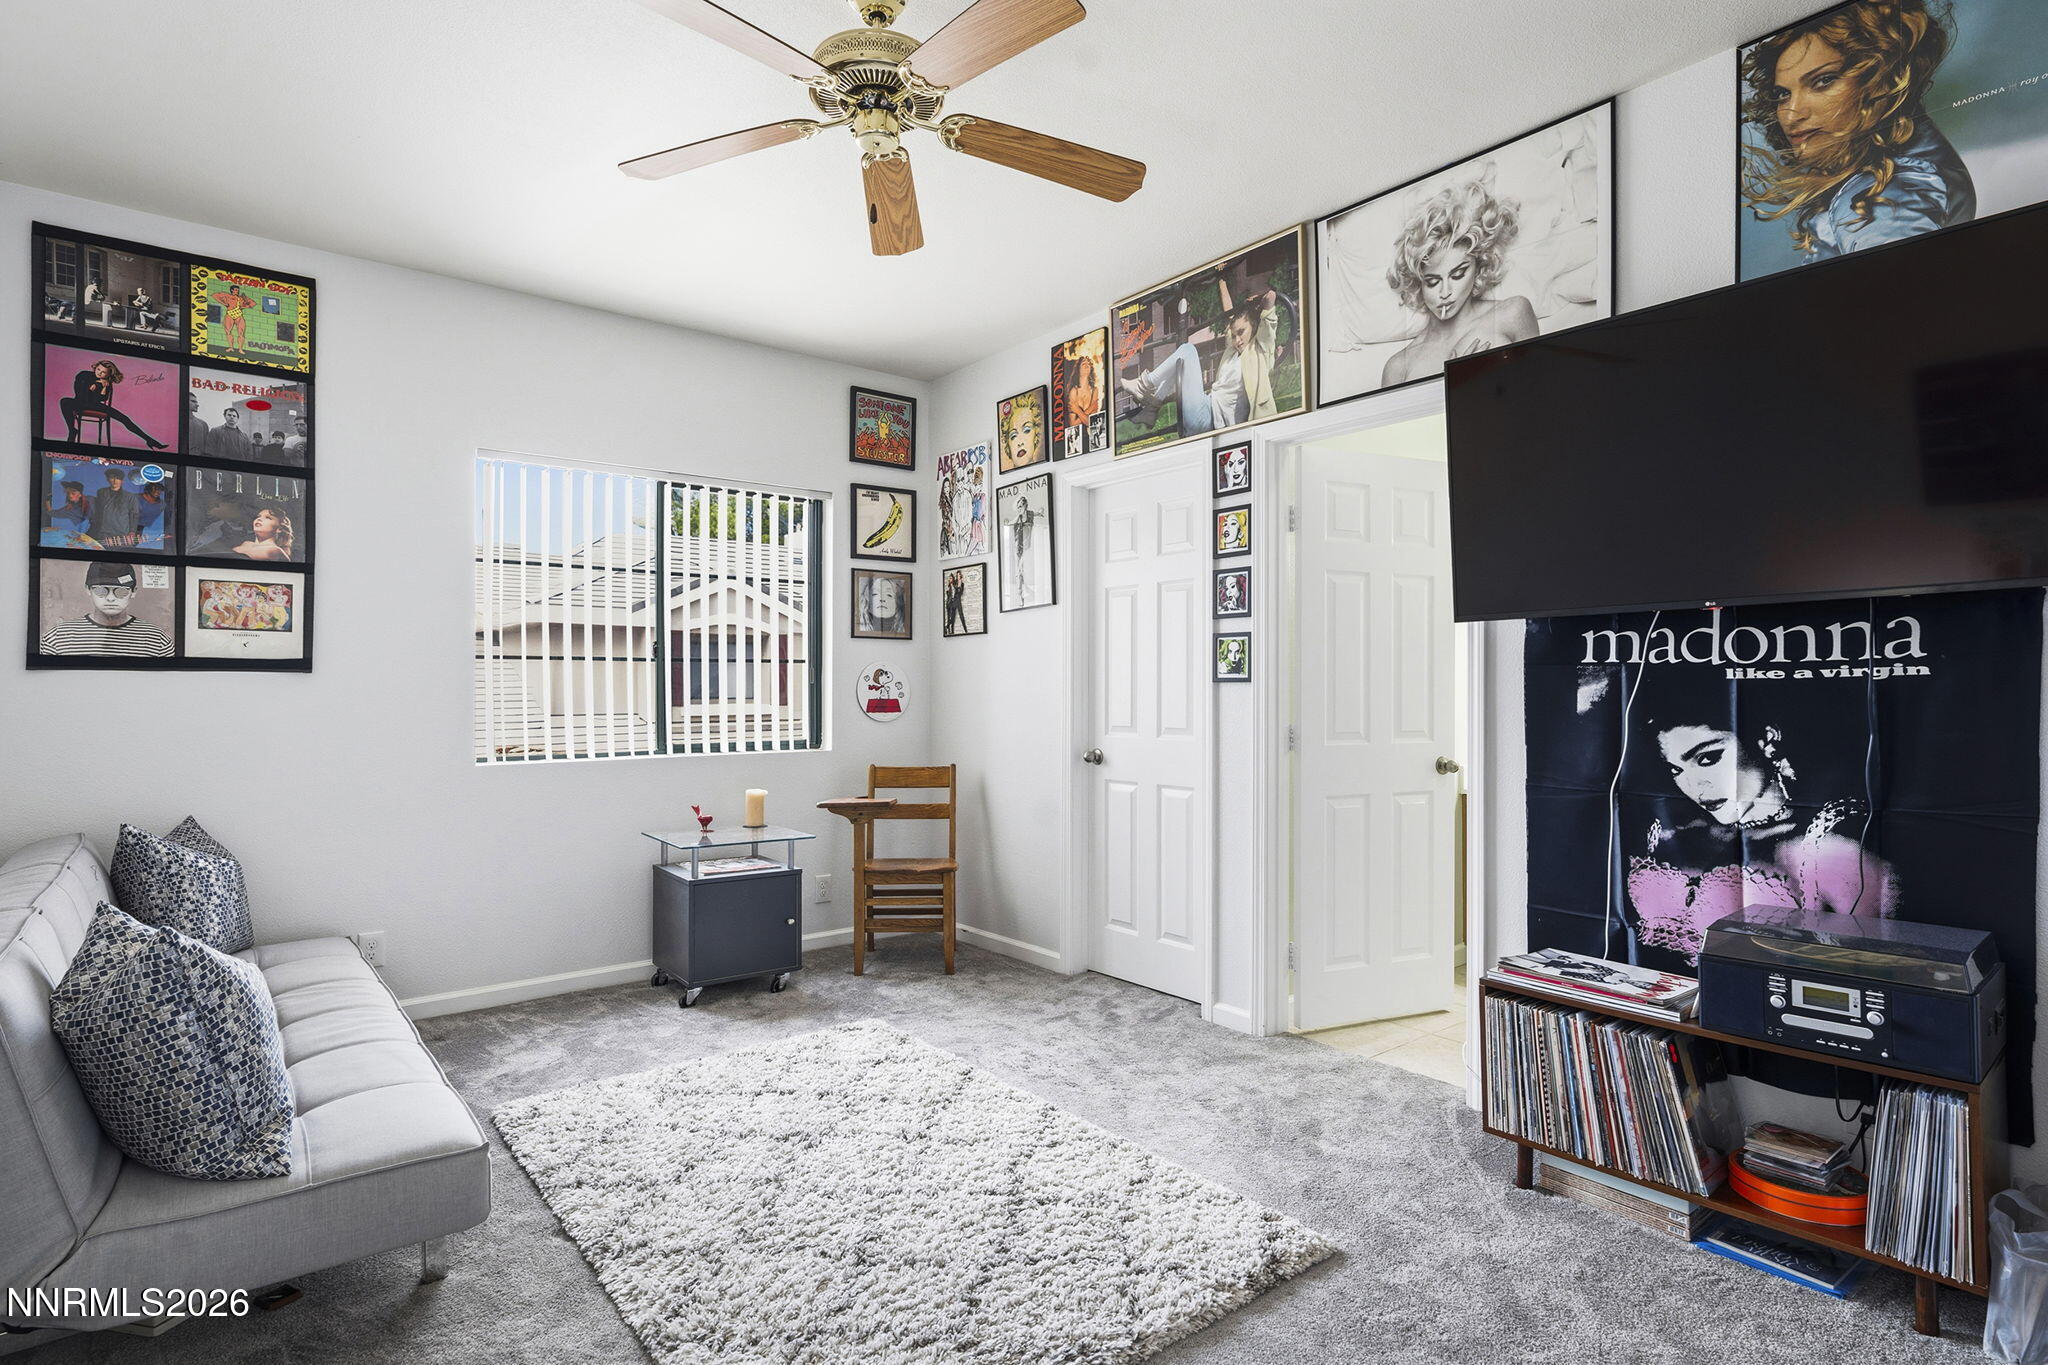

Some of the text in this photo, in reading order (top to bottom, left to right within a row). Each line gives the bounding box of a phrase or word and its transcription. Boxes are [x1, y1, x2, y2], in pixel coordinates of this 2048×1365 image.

[1952, 87, 2005, 107] MADONNA
[2020, 76, 2039, 86] ray
[113, 338, 140, 346] UPSTAIRS
[192, 377, 304, 402] BAD RELIGION
[1053, 345, 1065, 442] MADONNA
[892, 414, 910, 429] YOU
[857, 446, 905, 463] SYLVESTER
[196, 470, 299, 499] BERLIN
[1581, 608, 1928, 665] madonna
[1725, 663, 1932, 680] like a virgin
